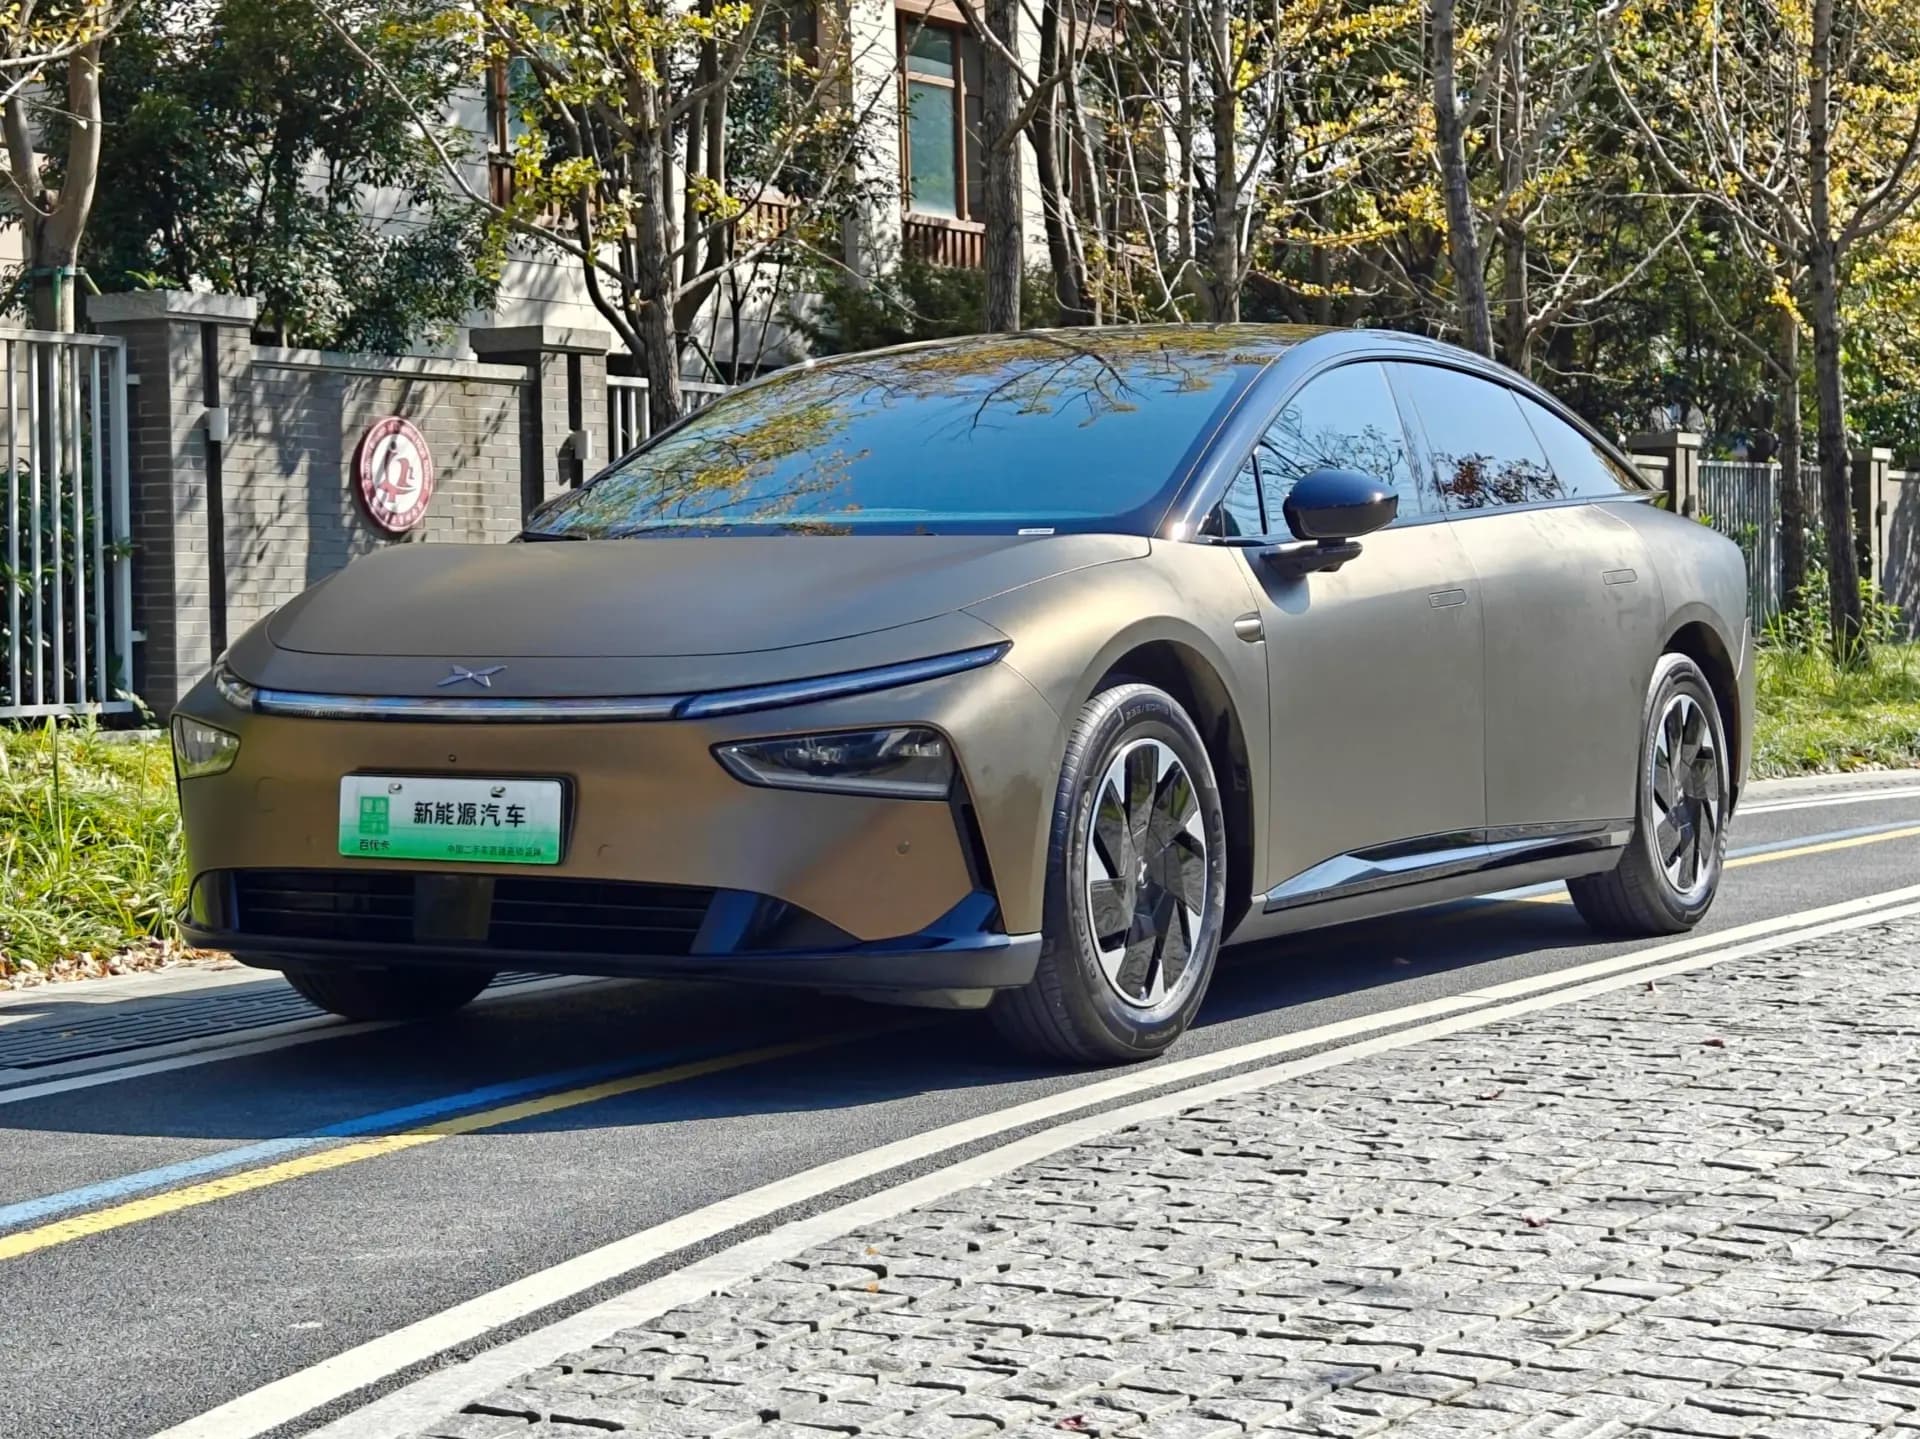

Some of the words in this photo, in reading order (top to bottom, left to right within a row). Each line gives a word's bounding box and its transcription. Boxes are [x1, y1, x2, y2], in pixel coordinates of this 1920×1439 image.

[413, 801, 526, 828] 新能源汽车
